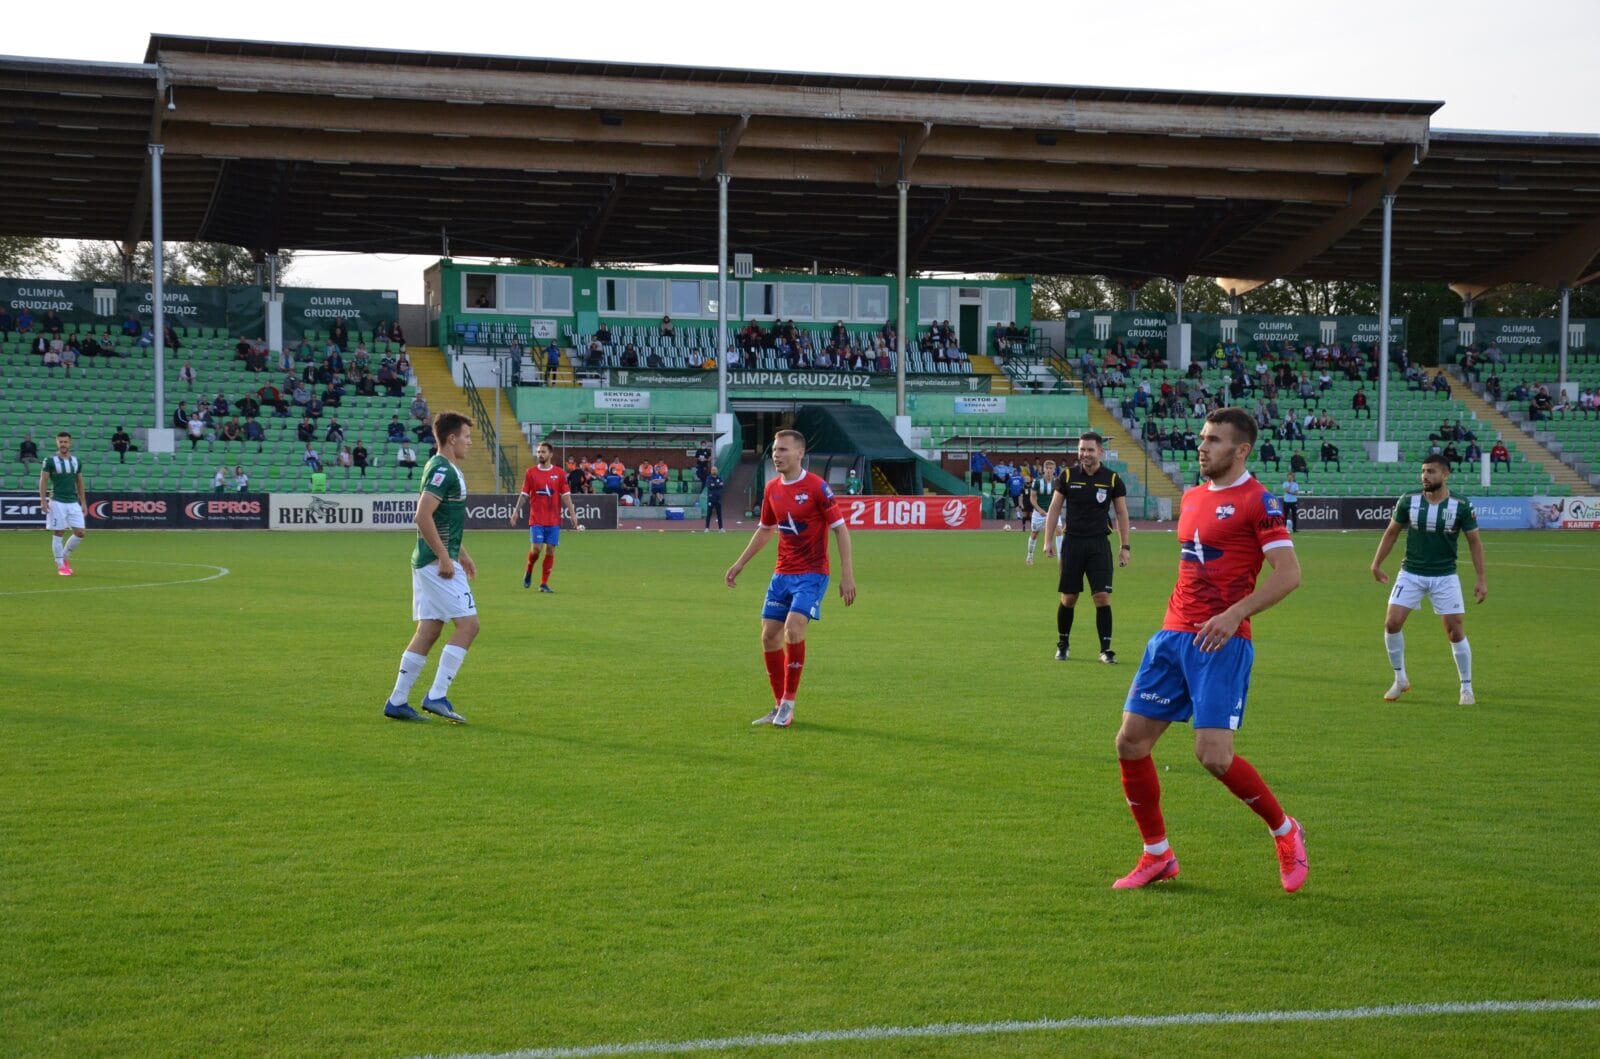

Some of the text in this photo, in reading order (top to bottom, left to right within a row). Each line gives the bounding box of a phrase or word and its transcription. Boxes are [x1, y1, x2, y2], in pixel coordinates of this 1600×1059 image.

[18, 288, 65, 298] OLIMPIA
[145, 293, 189, 302] OMPIA
[10, 300, 73, 312] GRUDZIĄDZ
[310, 297, 352, 306] OLIMPIA
[138, 304, 197, 316] GRDZIĄDZ
[304, 309, 360, 319] GRUDZIĄDZ
[1133, 318, 1167, 326] OLIMPIA
[1259, 322, 1293, 330] OLIMPIA
[1358, 324, 1392, 332] OLIMA
[1502, 325, 1535, 333] OLIMPIA
[1127, 330, 1168, 338] GRUDZIĄD
[1496, 336, 1541, 345] GRUDZIĄDZ
[788, 373, 870, 389] GRUDZIĄDZ
[905, 379, 960, 387] mpiagrudziadz.com
[112, 501, 167, 513] EPROS
[208, 501, 261, 513] EPROS
[372, 501, 417, 511] MATERI
[279, 507, 364, 524] REK-BUD
[850, 501, 926, 525] 2 LIGA
[1297, 506, 1339, 519] adain
[1356, 506, 1395, 519] vadai
[372, 512, 416, 524] BUDOW
[464, 591, 474, 608] 2
